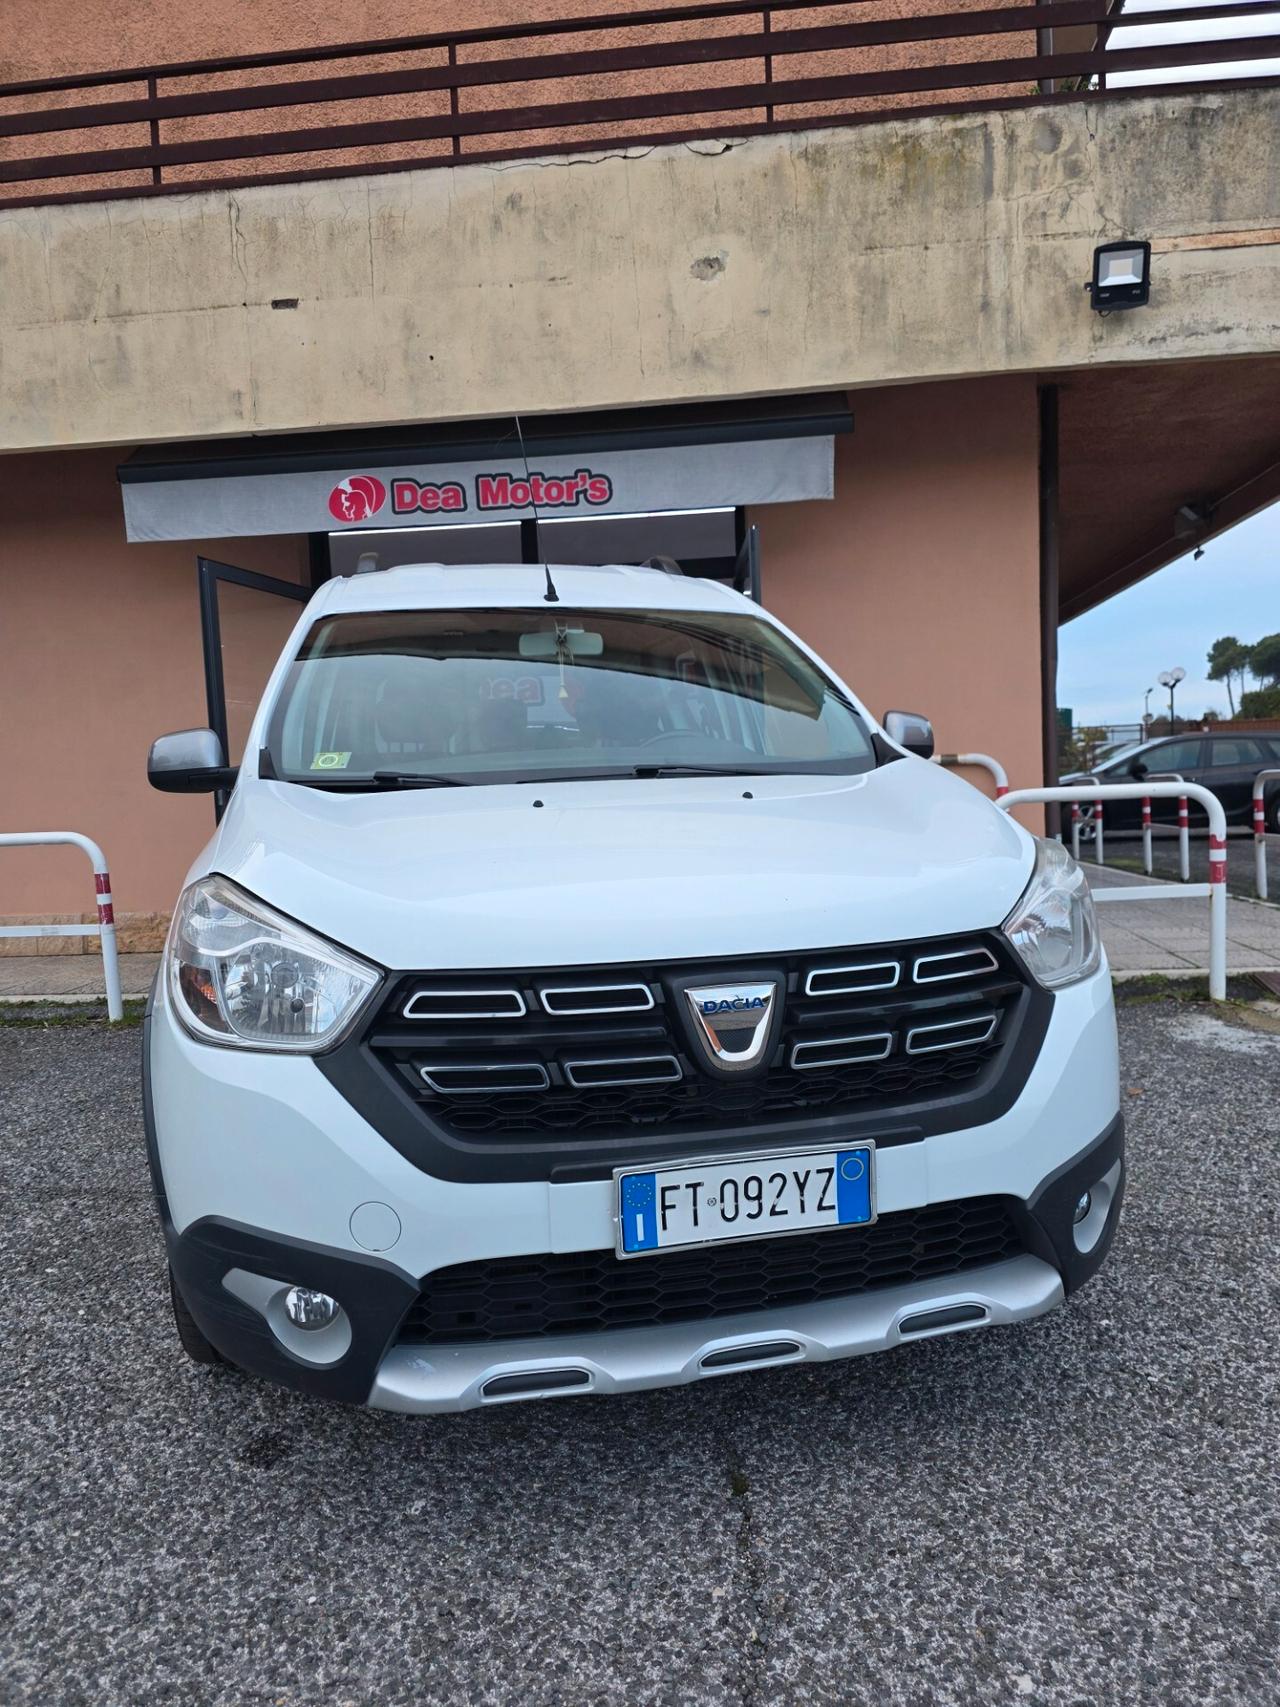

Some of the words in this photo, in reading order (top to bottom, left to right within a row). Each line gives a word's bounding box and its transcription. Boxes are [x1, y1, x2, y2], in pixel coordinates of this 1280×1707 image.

[393, 479, 466, 512] Dea
[477, 470, 611, 509] Motor's
[703, 996, 765, 1014] DACIA
[660, 1181, 705, 1231] FT
[719, 1167, 836, 1223] 092YZ
